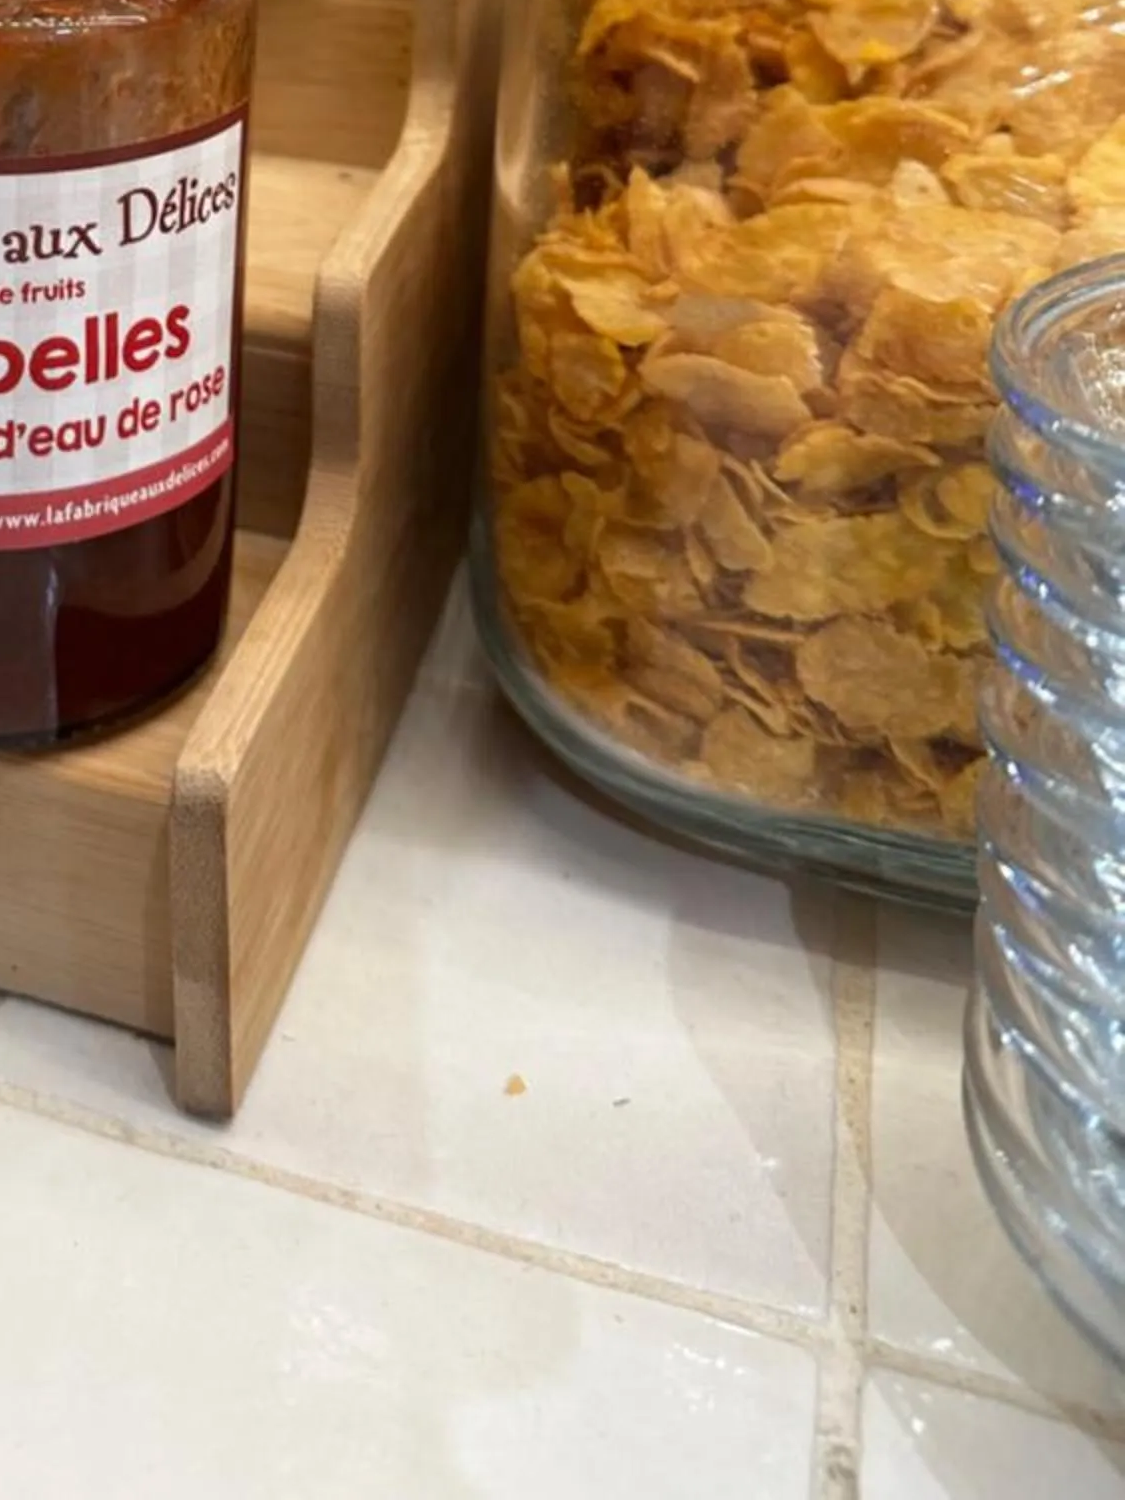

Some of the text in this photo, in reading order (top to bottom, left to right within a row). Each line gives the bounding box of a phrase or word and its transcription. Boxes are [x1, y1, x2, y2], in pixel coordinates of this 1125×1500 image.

[2, 221, 103, 264] aux
[117, 171, 237, 247] Délices
[21, 277, 86, 303] fruits
[116, 395, 162, 440] de
[169, 364, 225, 413] rose
